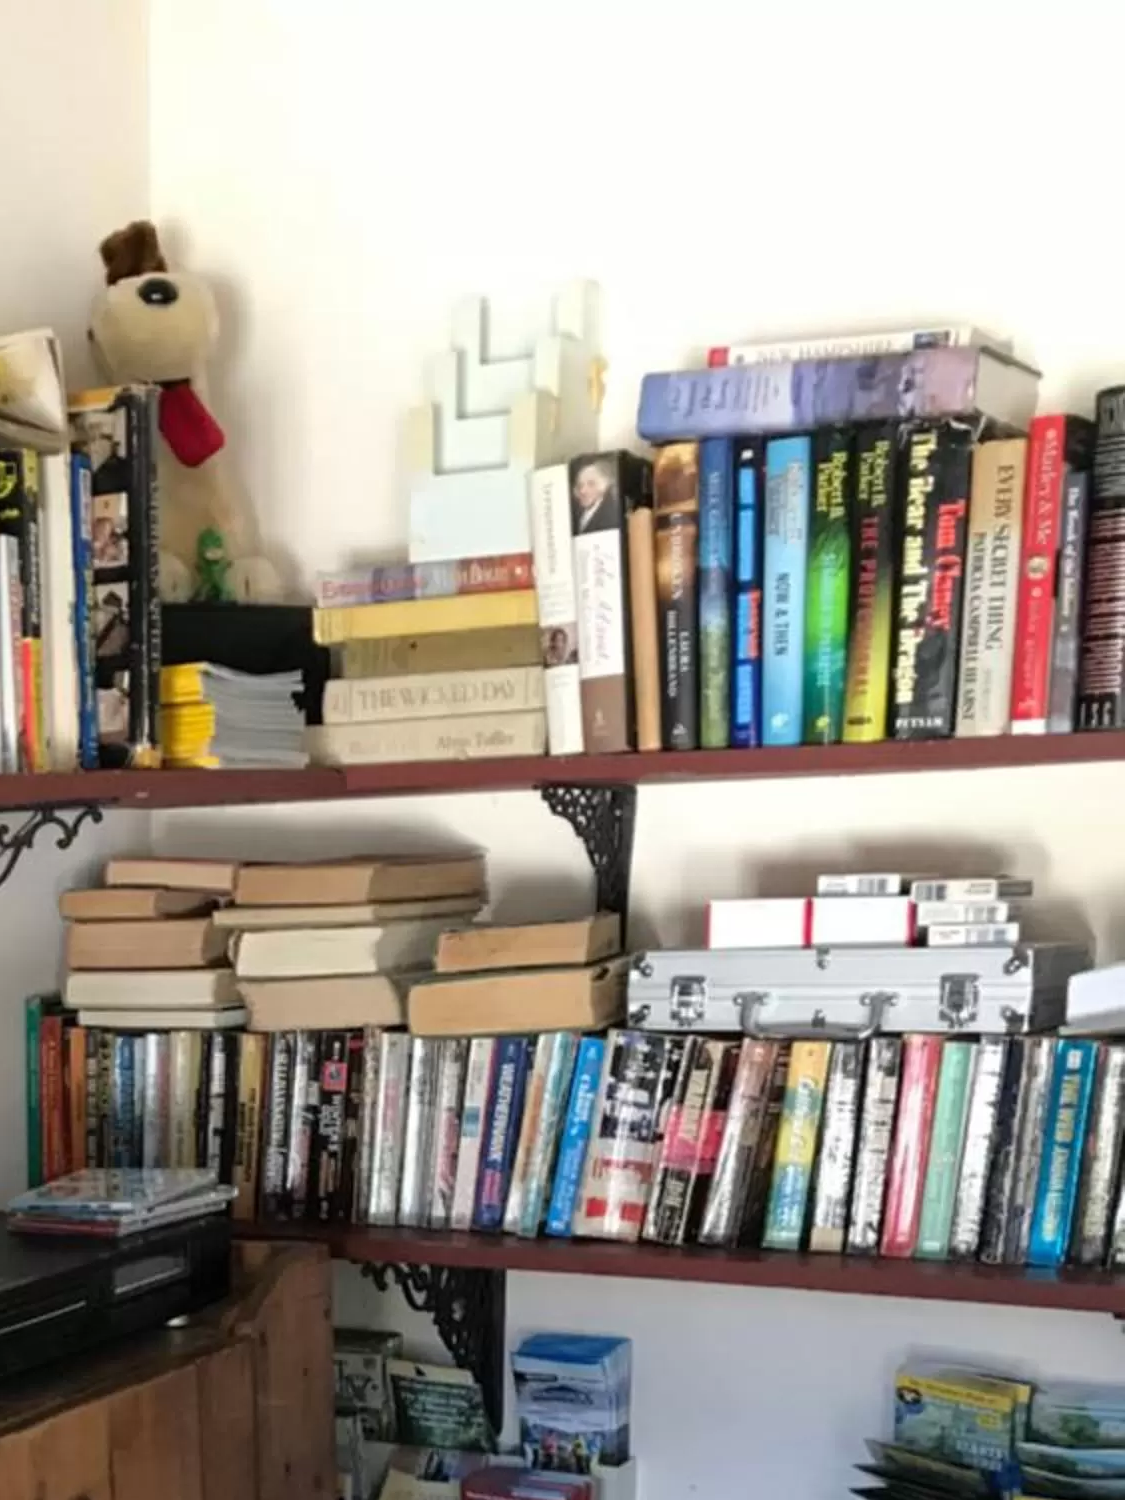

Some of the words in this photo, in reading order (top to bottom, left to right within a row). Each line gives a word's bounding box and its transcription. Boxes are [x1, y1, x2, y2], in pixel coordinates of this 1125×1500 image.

[874, 440, 890, 492] Robert
[910, 430, 937, 470] The
[816, 462, 831, 512] Parker
[830, 451, 847, 501] Robert
[858, 452, 873, 500] Parker
[994, 464, 1015, 519] EVERY
[906, 475, 934, 529] Bear
[937, 499, 966, 548] Tom
[861, 516, 879, 549] THE
[903, 534, 927, 577] and
[989, 523, 1010, 588] SECRET
[970, 531, 987, 592] PATRICIA
[899, 580, 927, 622] The
[926, 555, 962, 633] Clancy
[965, 595, 982, 664] CAMPBELL
[986, 595, 1008, 651] THING
[894, 628, 923, 704] Dragon
[358, 686, 396, 711] THE
[481, 677, 517, 702] DAY
